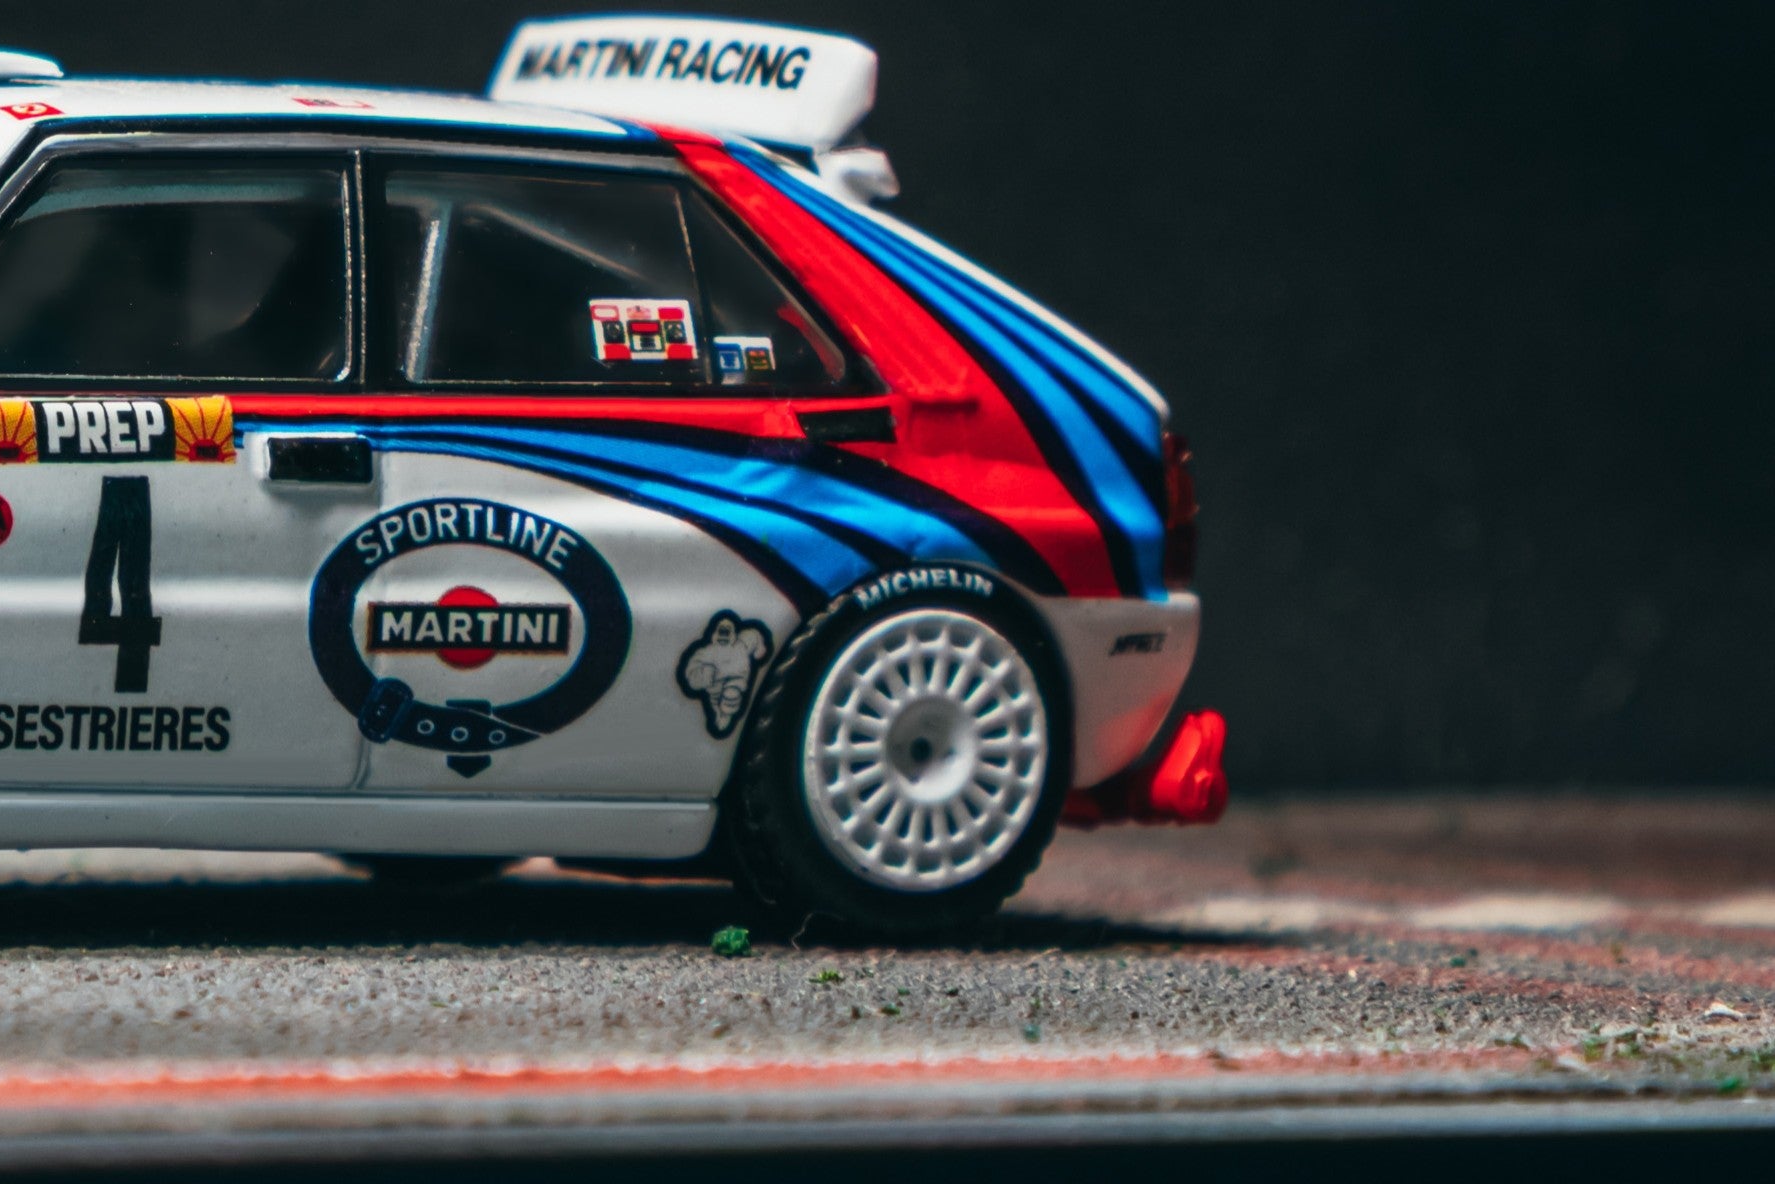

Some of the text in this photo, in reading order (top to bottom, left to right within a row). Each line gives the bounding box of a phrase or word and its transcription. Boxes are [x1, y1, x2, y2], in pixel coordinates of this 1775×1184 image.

[515, 37, 811, 90] MARTINI RACING
[41, 400, 166, 454] PREP
[356, 502, 578, 570] SPORTLINE
[78, 476, 162, 693] 4
[852, 568, 994, 611] MICHELIN
[381, 611, 559, 646] MARTINI
